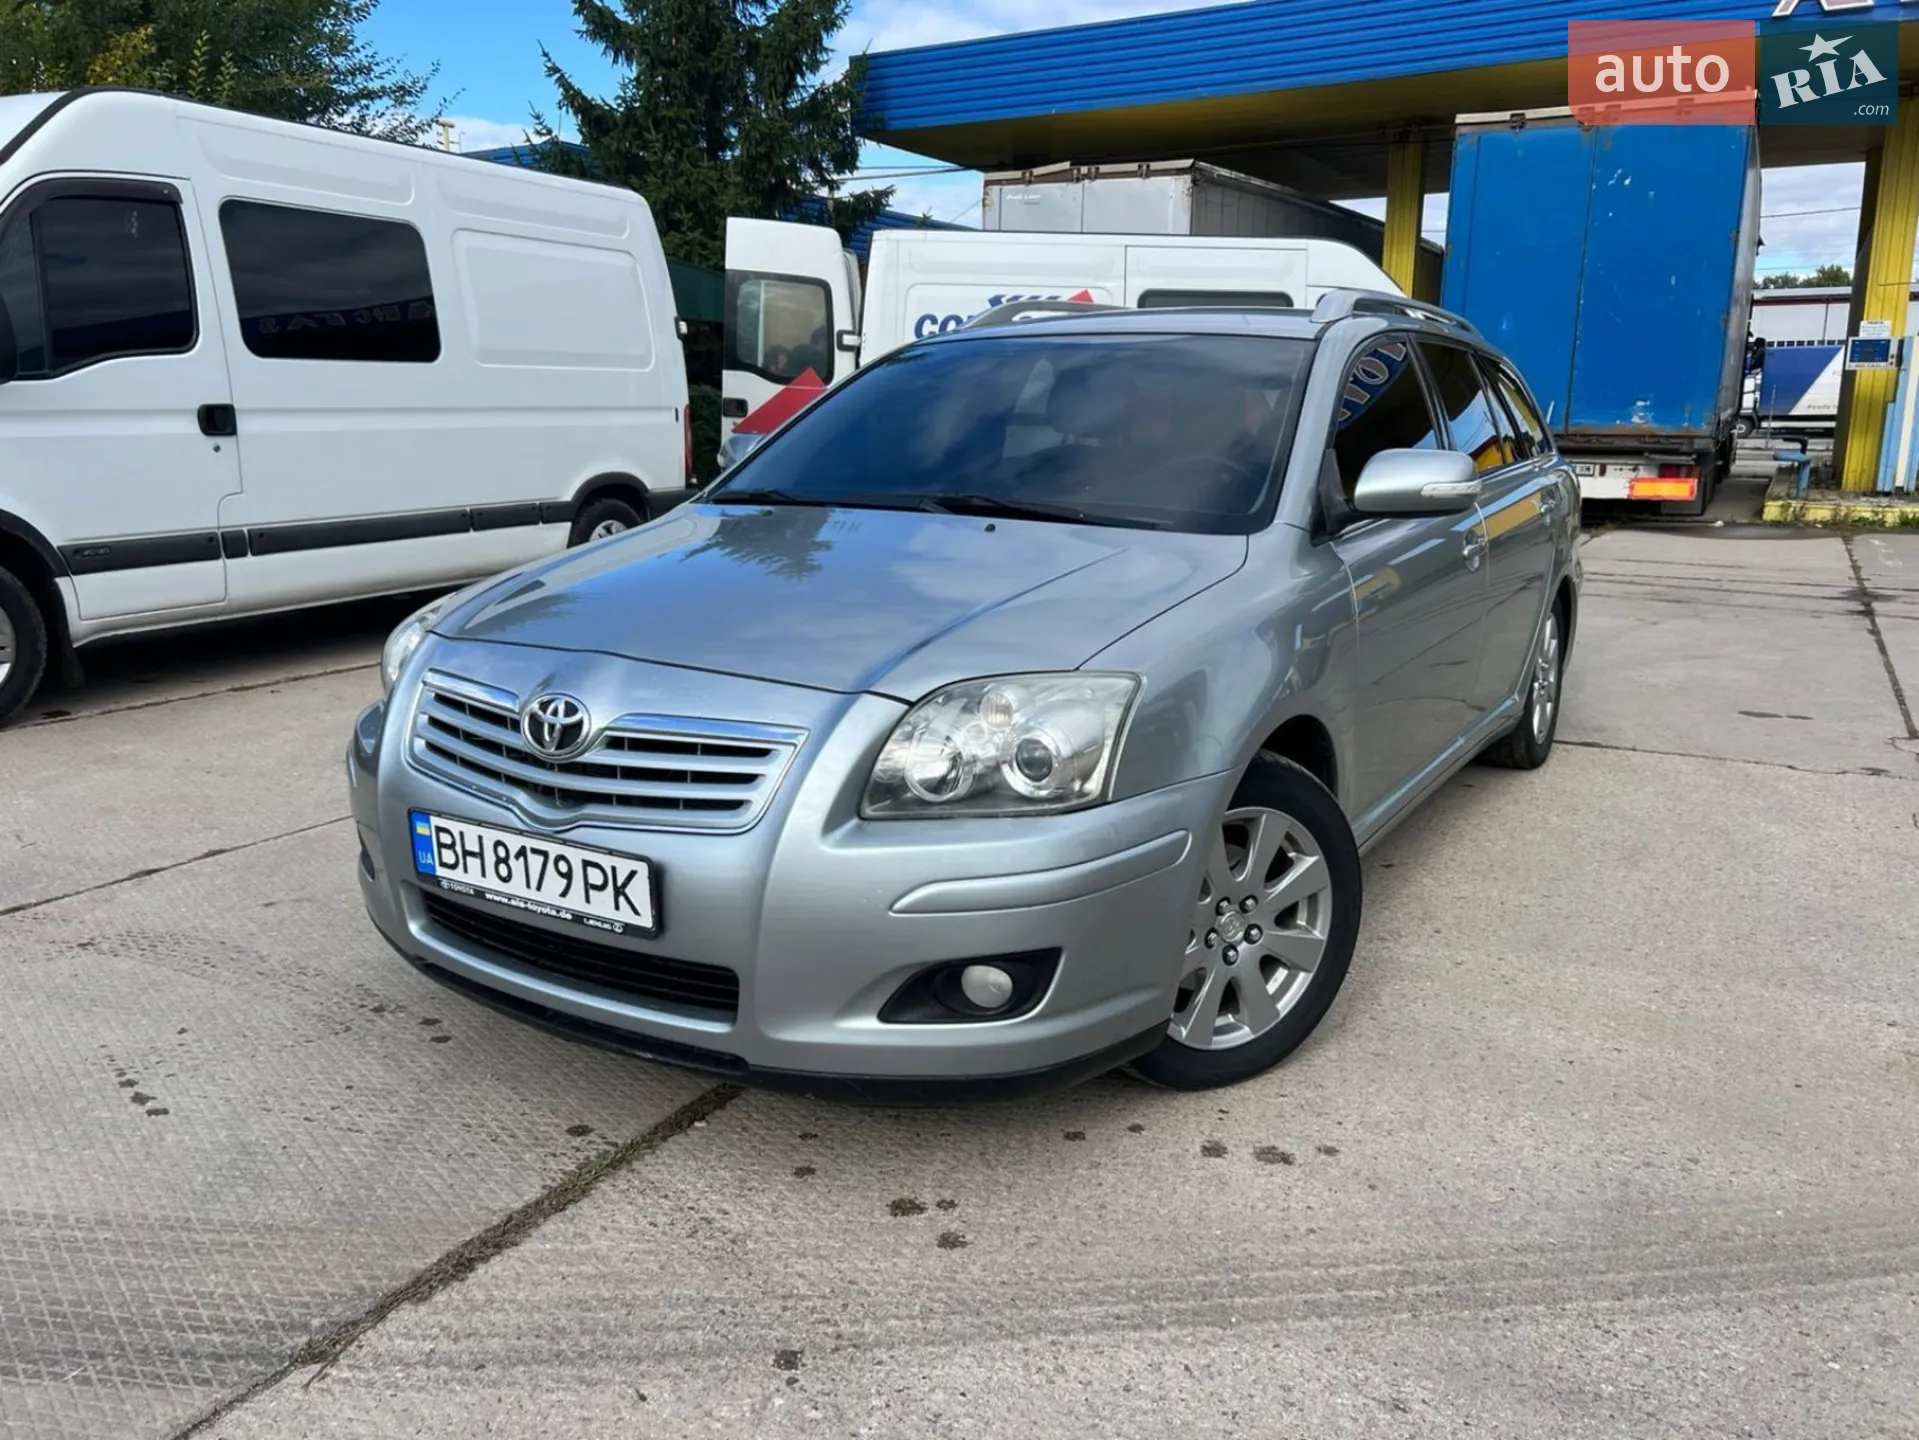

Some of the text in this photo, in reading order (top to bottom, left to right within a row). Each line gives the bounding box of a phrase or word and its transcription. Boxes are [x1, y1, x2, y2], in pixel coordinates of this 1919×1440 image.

[418, 851, 434, 867] UA
[434, 825, 642, 917] BH 8179 PK
